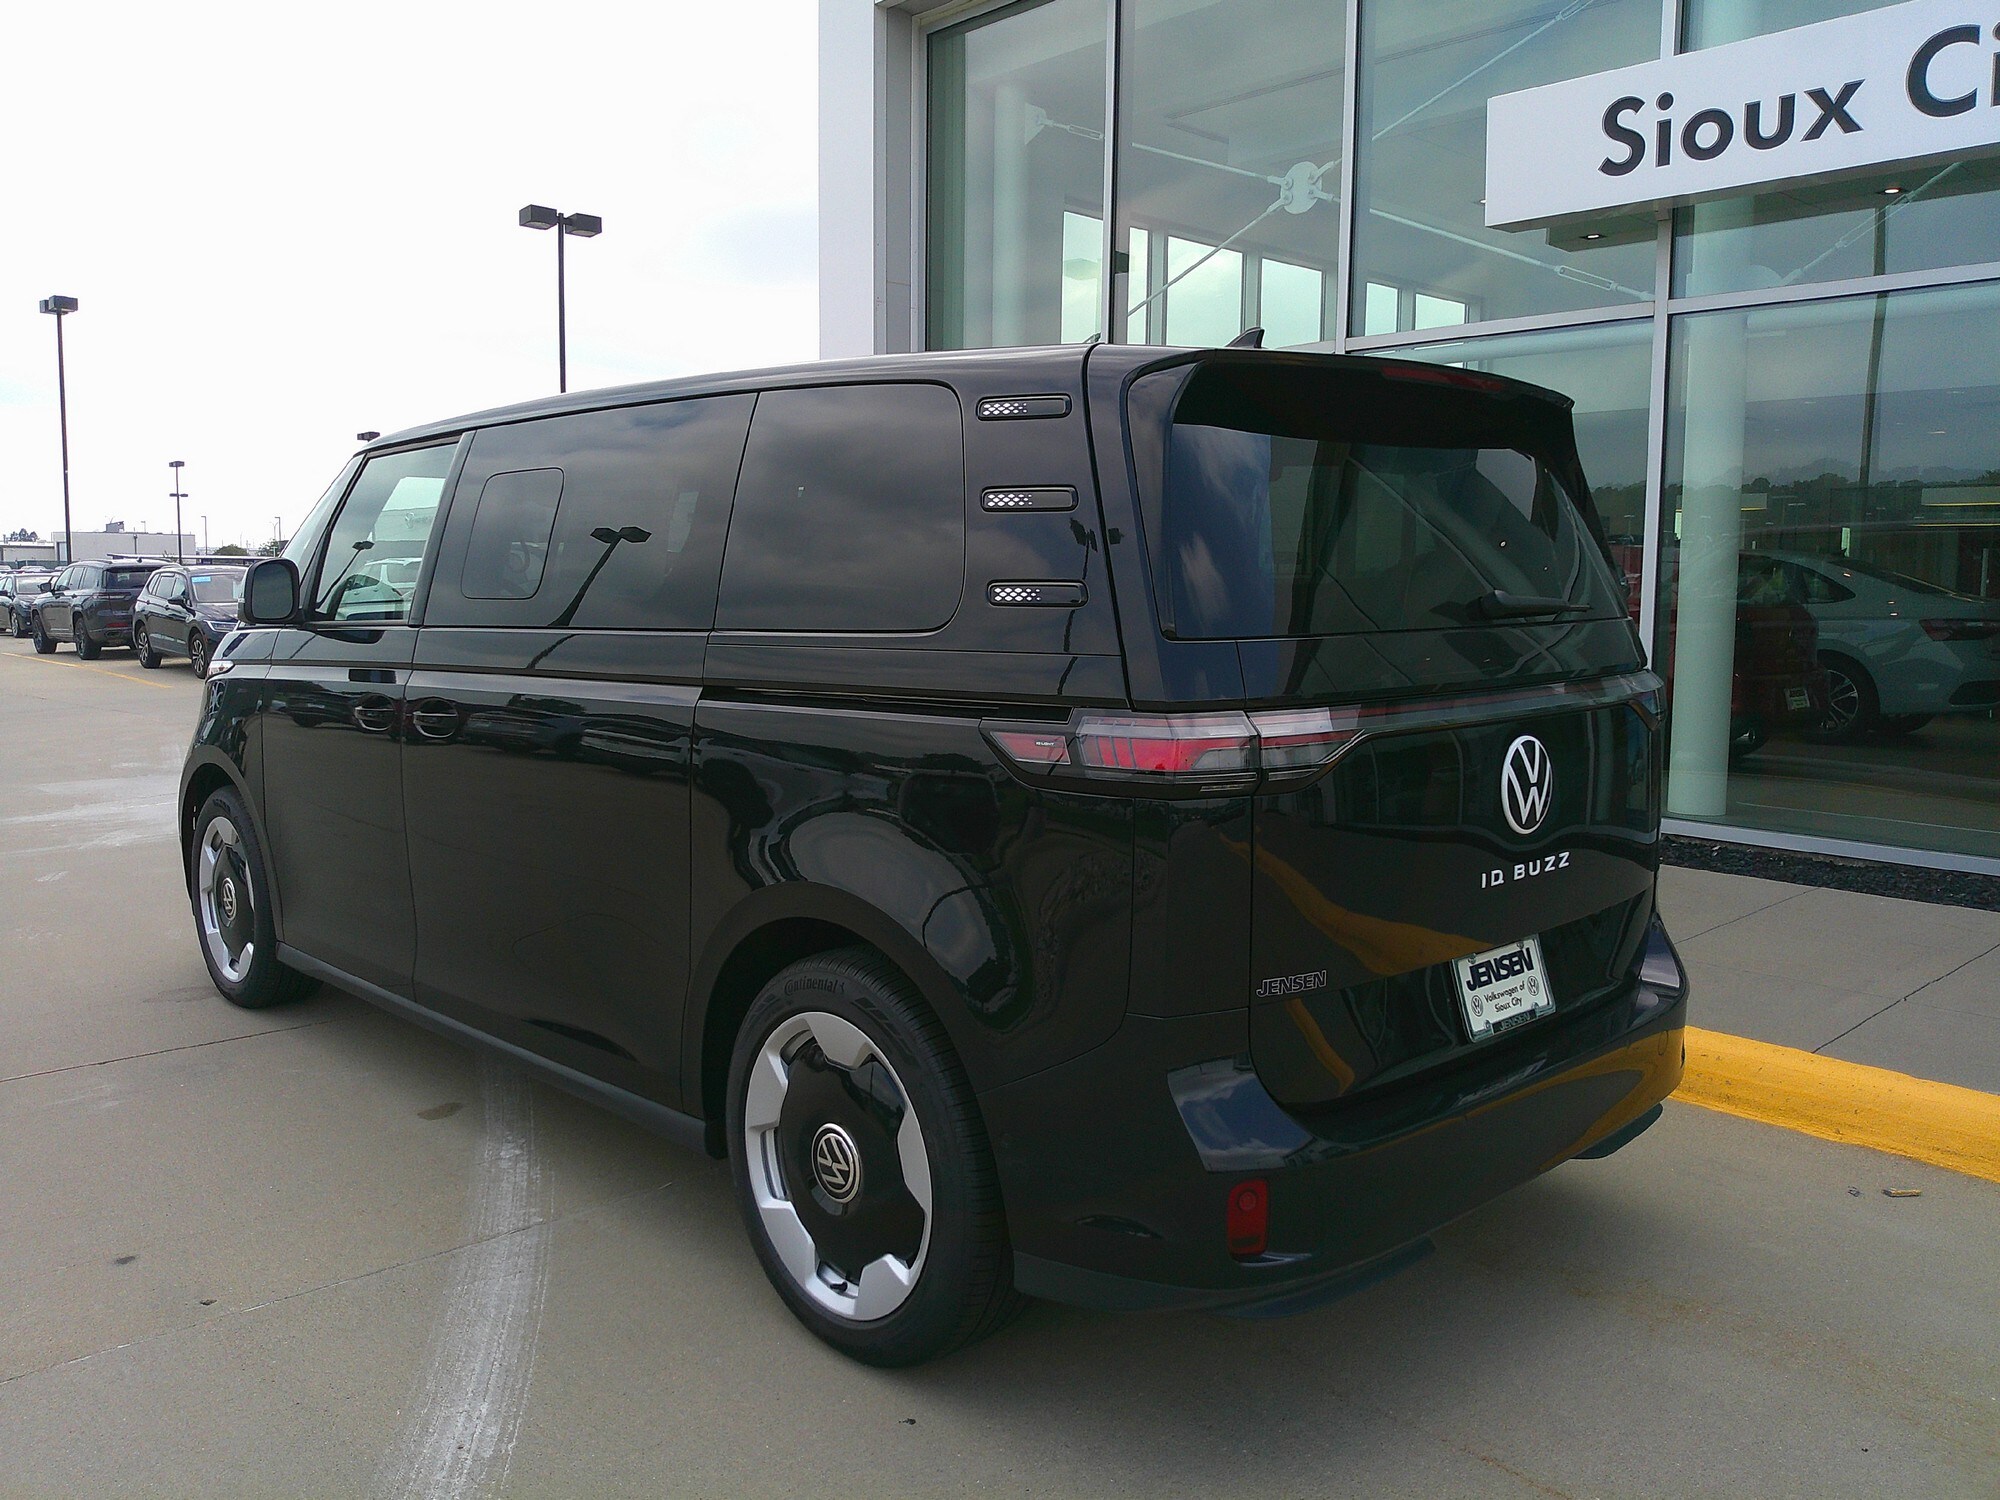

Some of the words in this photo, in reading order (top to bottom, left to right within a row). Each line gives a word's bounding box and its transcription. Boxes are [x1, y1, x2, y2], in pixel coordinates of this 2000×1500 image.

[1598, 79, 1865, 176] Sioux
[1514, 851, 1570, 880] BUZZ
[1256, 969, 1327, 997] JENSEN
[1466, 947, 1534, 991] JENSEN
[784, 975, 838, 996] Continental
[1484, 985, 1519, 1003] Volkswagen
[1519, 980, 1525, 991] of
[1495, 1002, 1512, 1012] Sioux
[1511, 996, 1522, 1007] City
